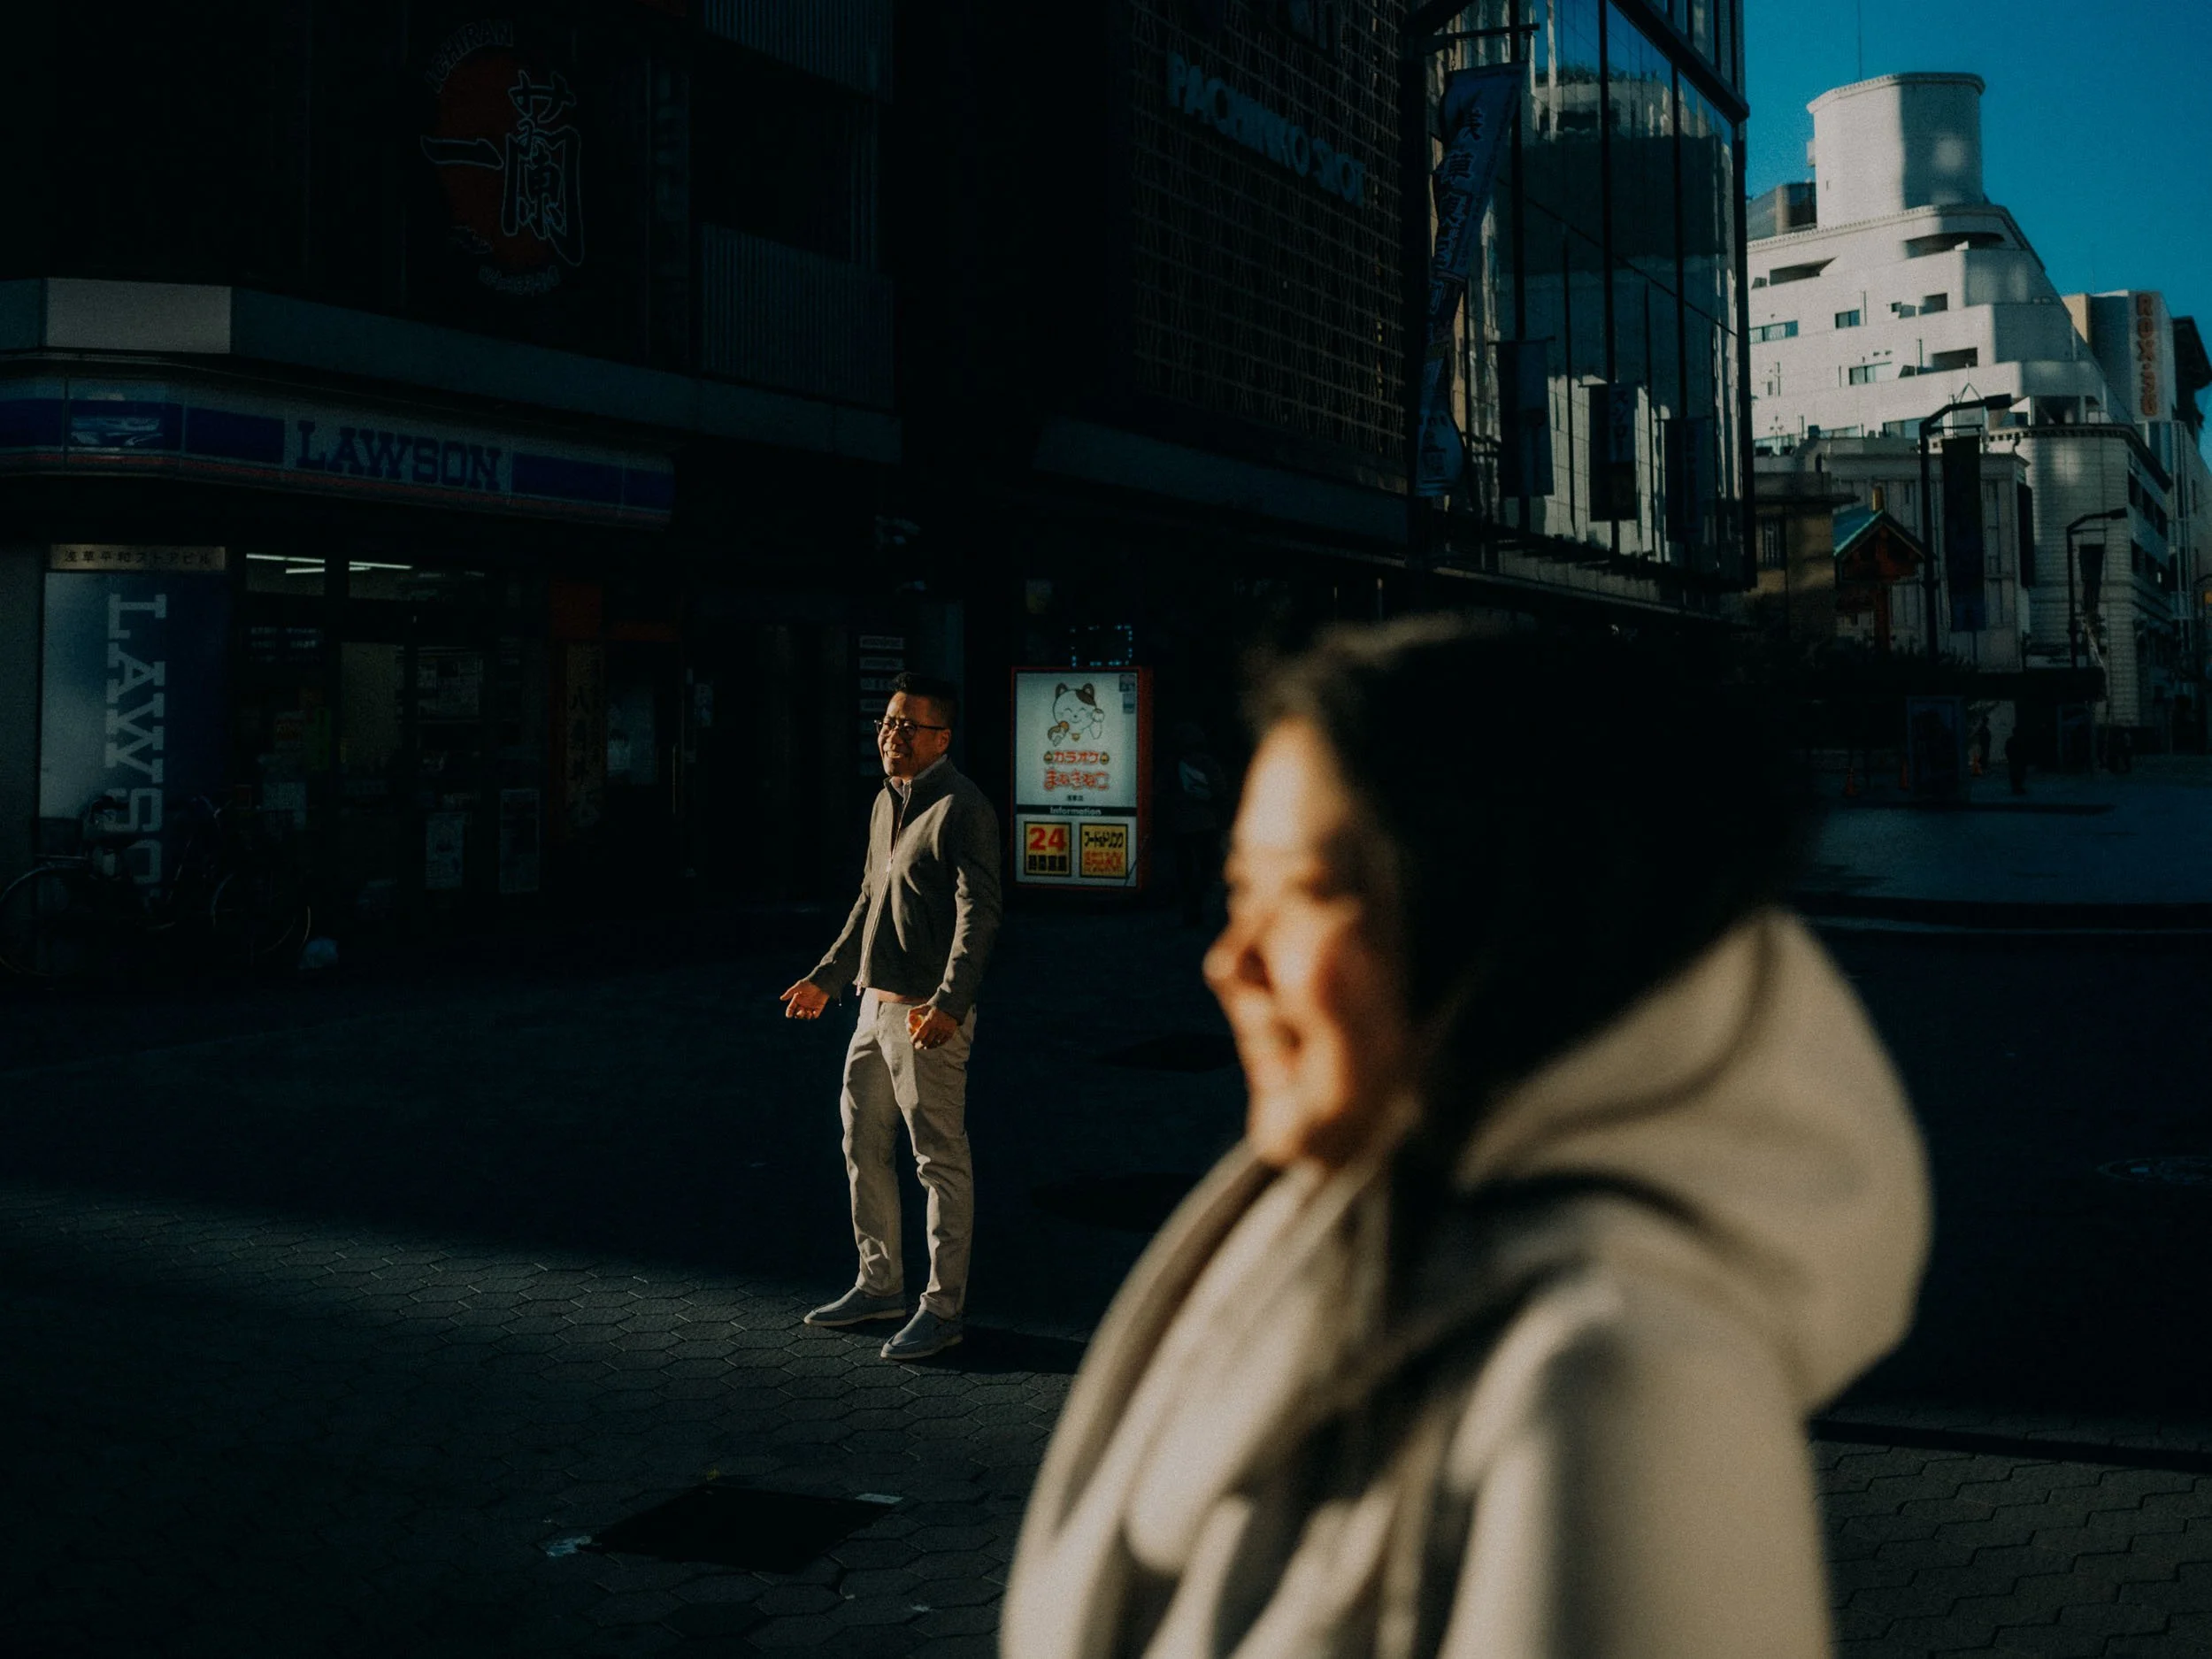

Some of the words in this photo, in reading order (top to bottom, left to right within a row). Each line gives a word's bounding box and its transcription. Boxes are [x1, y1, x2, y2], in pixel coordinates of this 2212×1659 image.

[296, 419, 503, 492] LAWSON
[1049, 806, 1103, 817] Information
[1029, 826, 1068, 852] 24
